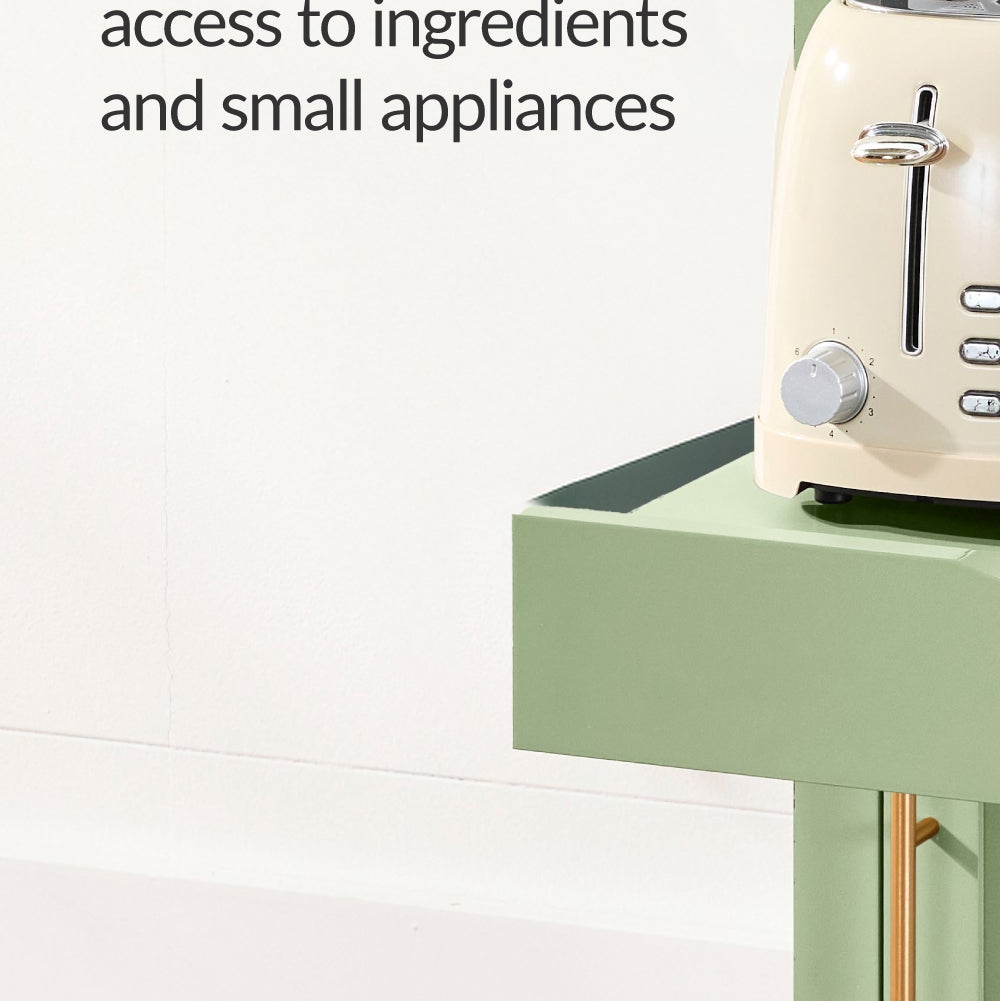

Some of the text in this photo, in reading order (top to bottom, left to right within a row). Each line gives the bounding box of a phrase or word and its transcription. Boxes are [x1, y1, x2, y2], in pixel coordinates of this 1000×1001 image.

[868, 357, 875, 367] 2
[868, 407, 875, 417] 3
[828, 429, 835, 438] 4
